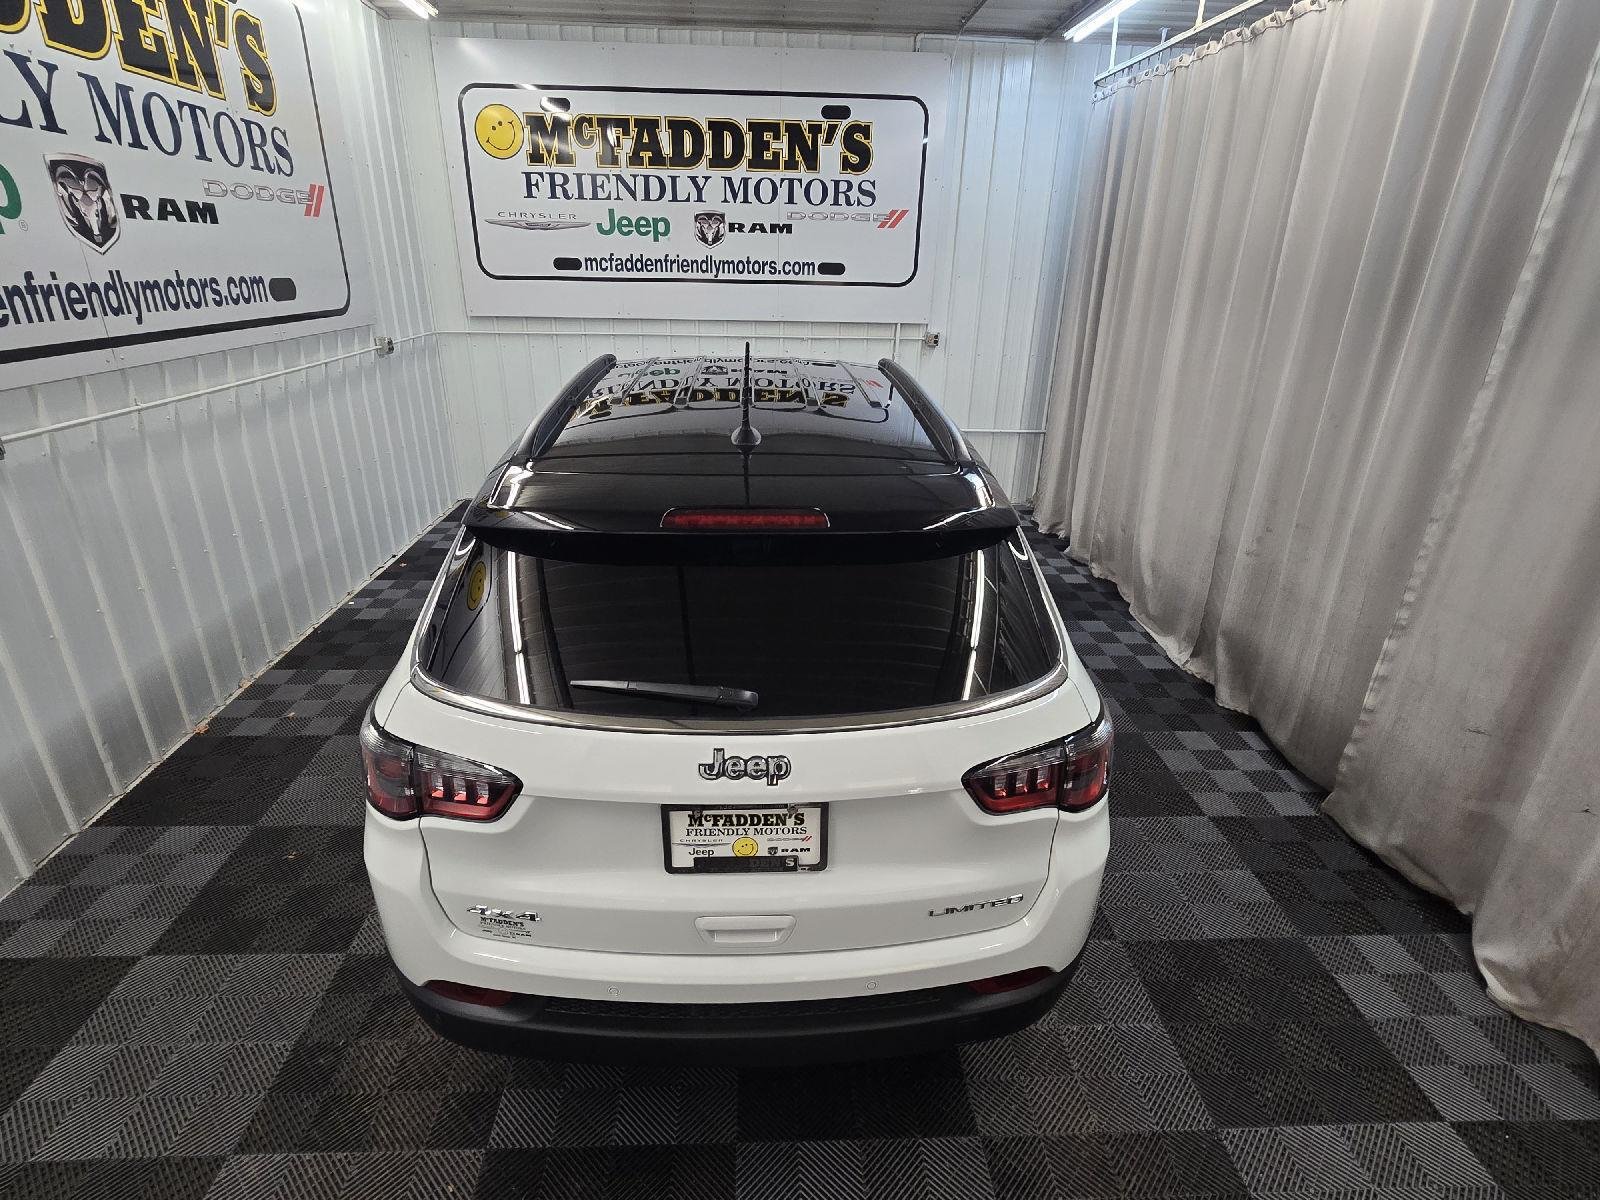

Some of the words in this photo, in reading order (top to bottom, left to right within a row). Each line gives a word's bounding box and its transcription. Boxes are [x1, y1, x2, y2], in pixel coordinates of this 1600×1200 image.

[76, 70, 295, 177] MOTORS
[201, 178, 314, 206] DODGE
[521, 171, 712, 204] FRIENDLY
[720, 175, 877, 207] MOTORS
[119, 192, 220, 225] RAM
[497, 210, 577, 220] CHRYSLER
[786, 211, 889, 222] DODGE
[596, 208, 671, 242] Jeep
[728, 221, 793, 234] RAM
[584, 251, 816, 279] mcfaddenfriendlymotors.com
[698, 748, 792, 786] Jeep
[686, 827, 751, 837] FRIENDLY
[753, 826, 807, 835] MOTORS
[688, 847, 715, 857] Jeep
[928, 893, 1024, 917] LIMITED
